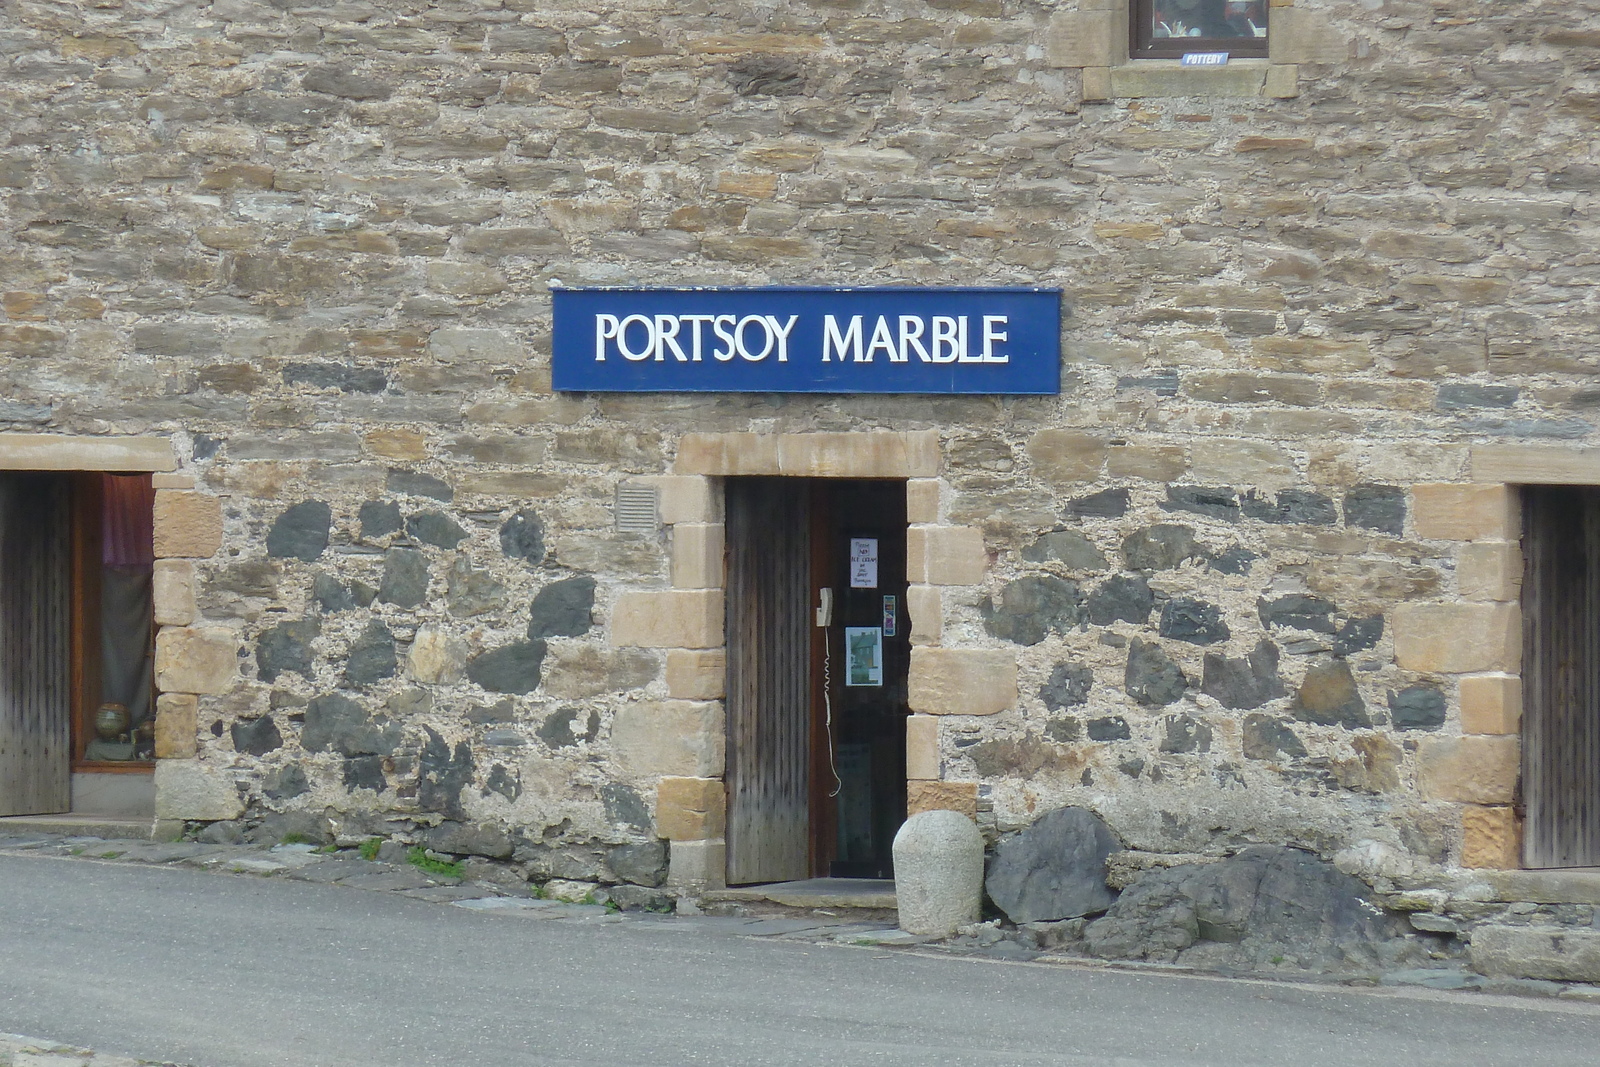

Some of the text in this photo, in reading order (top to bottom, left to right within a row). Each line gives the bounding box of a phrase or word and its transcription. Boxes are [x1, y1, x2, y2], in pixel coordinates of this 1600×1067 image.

[1186, 54, 1223, 64] POTTERY
[595, 314, 1009, 363] PORTSOY MARBLE
